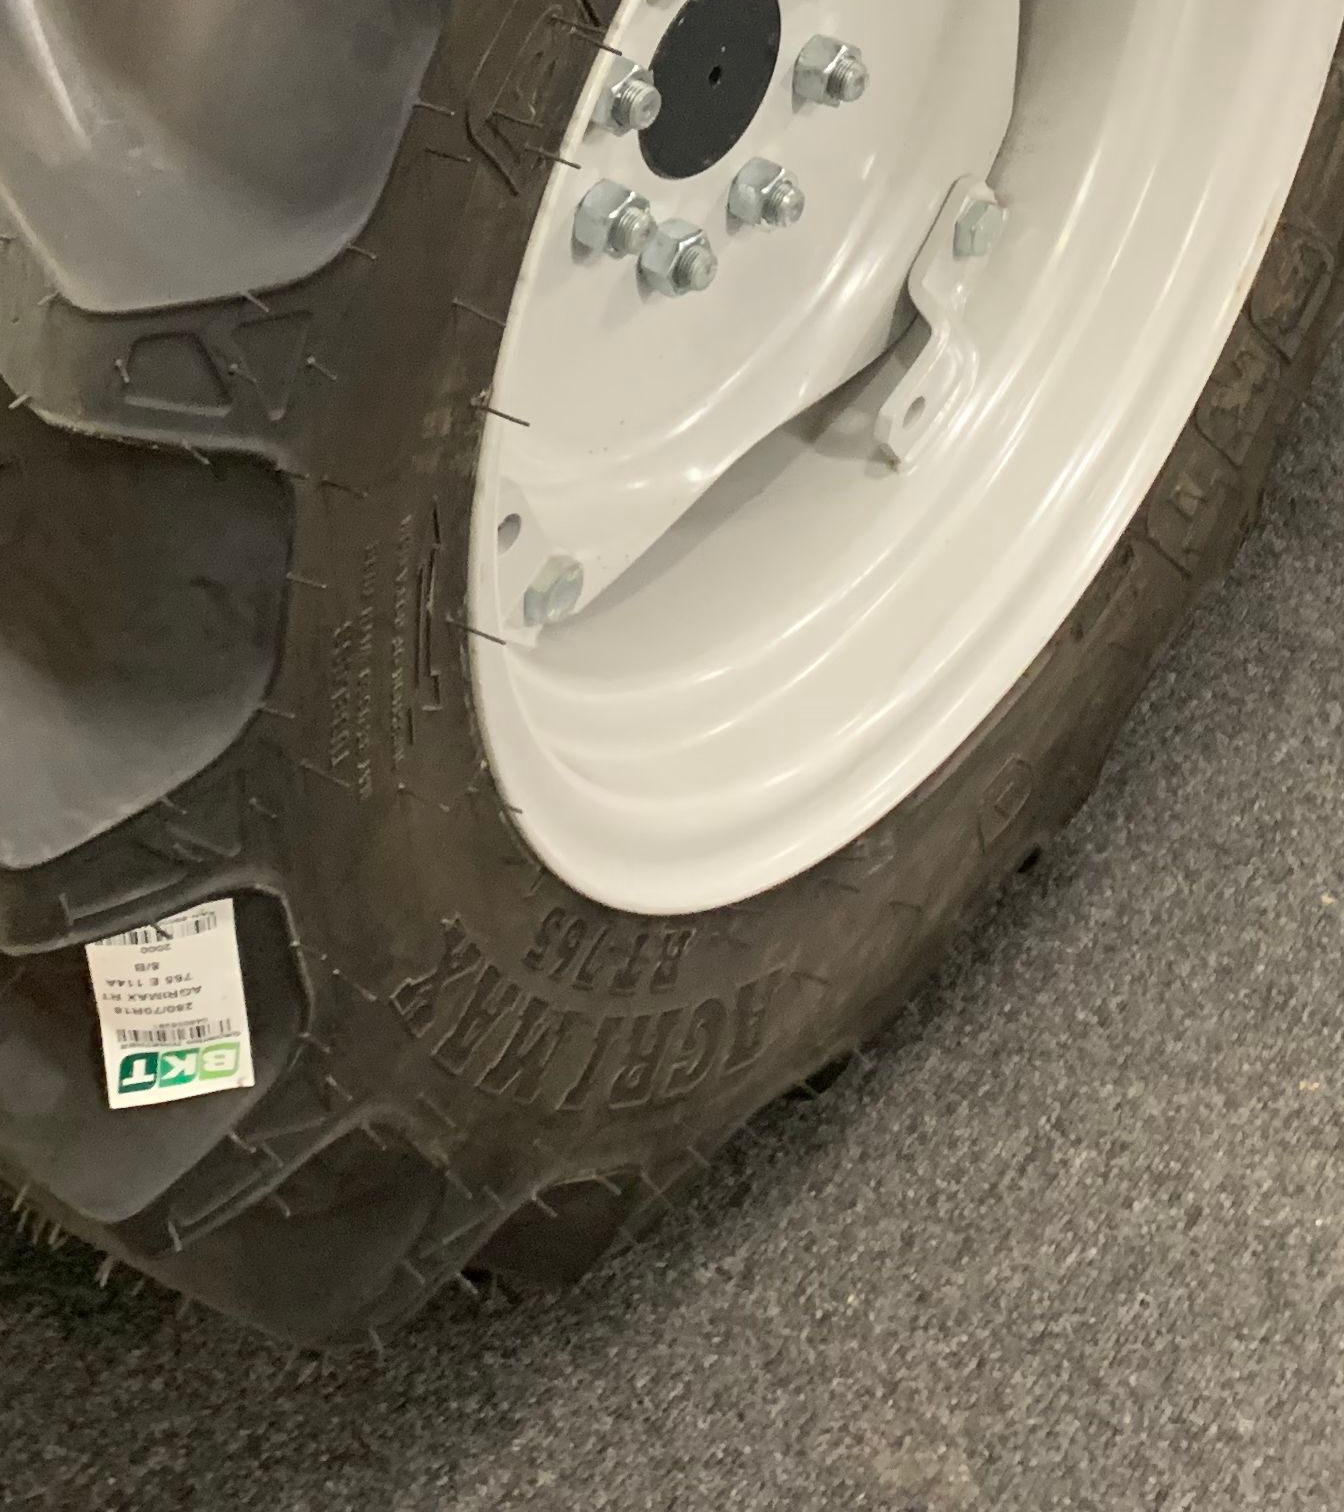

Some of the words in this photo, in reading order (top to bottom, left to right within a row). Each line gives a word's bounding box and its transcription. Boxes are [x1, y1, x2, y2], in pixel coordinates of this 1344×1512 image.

[104, 976, 144, 988] 114A
[128, 986, 203, 1001] AGRIMAX
[389, 914, 790, 1111] AGRIMAX
[120, 1046, 239, 1089] BKT
